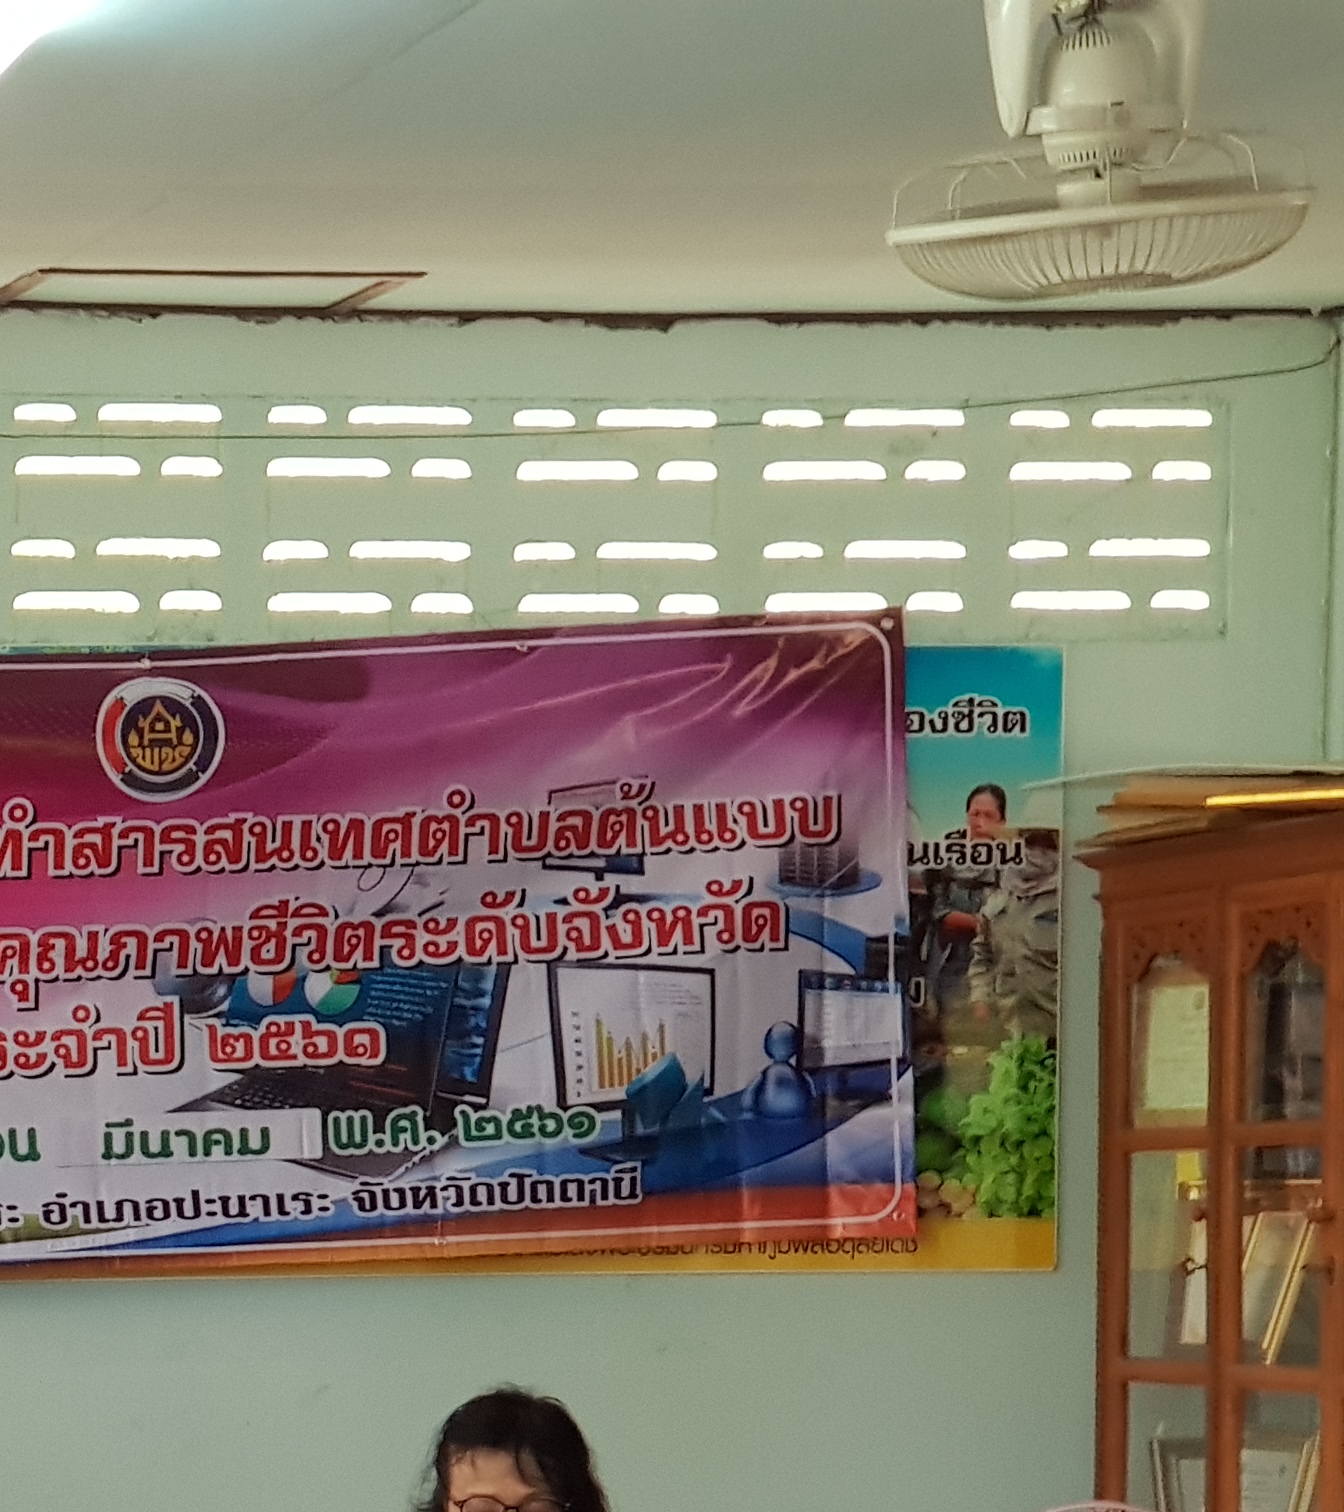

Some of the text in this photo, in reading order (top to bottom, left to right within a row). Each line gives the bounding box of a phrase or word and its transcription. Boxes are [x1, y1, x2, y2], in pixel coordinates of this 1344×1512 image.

[205, 1016, 386, 1069] ๒๕๖๑
[101, 1118, 271, 1161] มีนาคม
[332, 1109, 437, 1149] พ.ศ.
[459, 1104, 598, 1142] ๒๕๖๑
[42, 1190, 330, 1227] อำเภอปะนาเระ
[352, 1166, 641, 1212] จังหวัดปัตตานี
